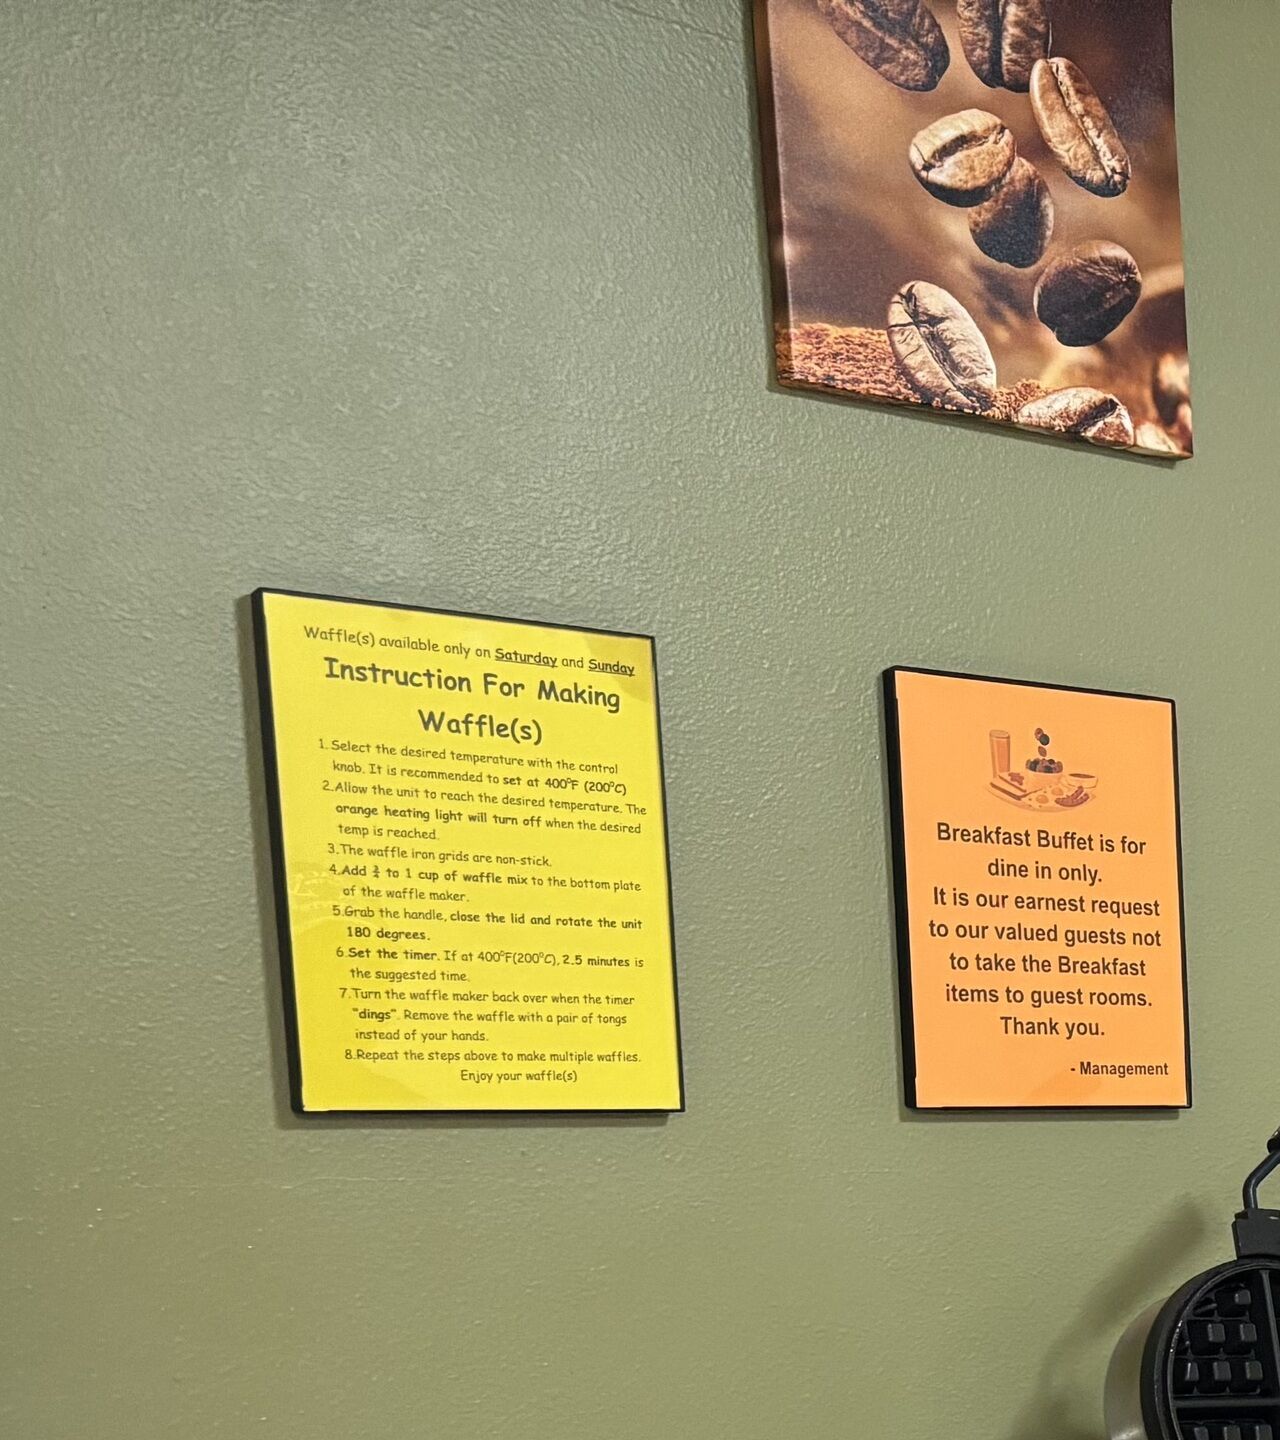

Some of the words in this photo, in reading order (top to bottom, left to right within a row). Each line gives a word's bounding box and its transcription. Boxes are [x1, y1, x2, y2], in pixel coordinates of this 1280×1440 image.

[303, 625, 376, 648] Waffle(s)
[378, 636, 441, 653] available
[443, 642, 471, 660] only
[474, 647, 492, 659] on
[494, 647, 559, 669] Saturday
[561, 656, 585, 669] and
[587, 658, 636, 678] Sunday
[323, 656, 472, 694] Instruction
[482, 672, 526, 698] For
[537, 679, 621, 715] Making
[417, 708, 543, 747] Waffle(s)
[374, 743, 398, 756] the
[400, 745, 447, 760] desired
[449, 750, 525, 767] temperature
[526, 757, 553, 770] with
[555, 759, 577, 772] the
[578, 763, 619, 775] control
[367, 762, 383, 775] It
[386, 764, 398, 777] is
[400, 768, 484, 783] recommended
[485, 773, 500, 785] to
[502, 776, 523, 786] set
[526, 777, 541, 788] at
[335, 804, 379, 819] orange
[383, 804, 431, 823] heating
[434, 808, 464, 824] light
[467, 811, 488, 823] will
[491, 813, 519, 826] turn
[522, 815, 543, 828] off
[544, 816, 575, 830] when
[576, 818, 598, 831] the
[599, 820, 642, 834] desired
[337, 823, 370, 839] temp
[372, 825, 384, 837] is
[936, 821, 1032, 848] Breakfast
[1036, 829, 1095, 852] Buffet
[1099, 833, 1116, 853] is
[1119, 835, 1147, 855] for
[366, 845, 409, 859] waffle
[411, 847, 436, 861] iron
[438, 850, 470, 864] grids
[472, 854, 493, 864] are
[987, 857, 1029, 879] dine
[1034, 860, 1052, 880] in
[1058, 863, 1103, 887] only.
[933, 885, 947, 906] It
[952, 887, 970, 907] is
[975, 893, 1010, 909] our
[1014, 895, 1086, 913] earnest
[1091, 899, 1161, 919] request
[377, 907, 401, 920] the
[449, 909, 481, 923] close
[484, 911, 506, 924] the
[510, 912, 526, 925] lid
[529, 914, 552, 926] and
[555, 916, 594, 928] rotate
[596, 916, 618, 929] the
[621, 918, 643, 930] unit
[346, 925, 372, 938] 180
[928, 919, 949, 938] to
[954, 924, 990, 940] our
[993, 922, 1058, 943] valued
[1064, 927, 1127, 948] guests
[1132, 930, 1162, 947] not
[948, 952, 969, 971] to
[974, 952, 1017, 972] take
[1021, 953, 1052, 973] the
[1057, 955, 1147, 977] Breakfast
[945, 983, 1000, 1003] items
[1004, 985, 1025, 1004] to
[1030, 987, 1084, 1008] guest
[1089, 991, 1153, 1007] rooms.
[403, 1008, 450, 1021] Remove
[452, 1009, 474, 1022] the
[476, 1009, 516, 1023] waffle
[517, 1011, 544, 1023] with
[545, 1014, 554, 1023] a
[556, 1012, 579, 1026] pair
[581, 1011, 594, 1025] of
[596, 1013, 628, 1028] tongs
[999, 1016, 1060, 1036] Thank
[1064, 1021, 1105, 1041] you.
[355, 1028, 401, 1041] instead
[403, 1028, 418, 1041] of
[420, 1032, 448, 1044] your
[402, 1049, 425, 1061] the
[427, 1050, 461, 1065] steps
[463, 1049, 499, 1062] above
[500, 1051, 514, 1062] to
[516, 1050, 547, 1062] make
[549, 1050, 594, 1065] multiple
[1079, 1061, 1169, 1078] Management
[460, 1069, 494, 1084] Enjoy
[495, 1072, 523, 1084] your
[525, 1069, 578, 1083] waffle(s)
